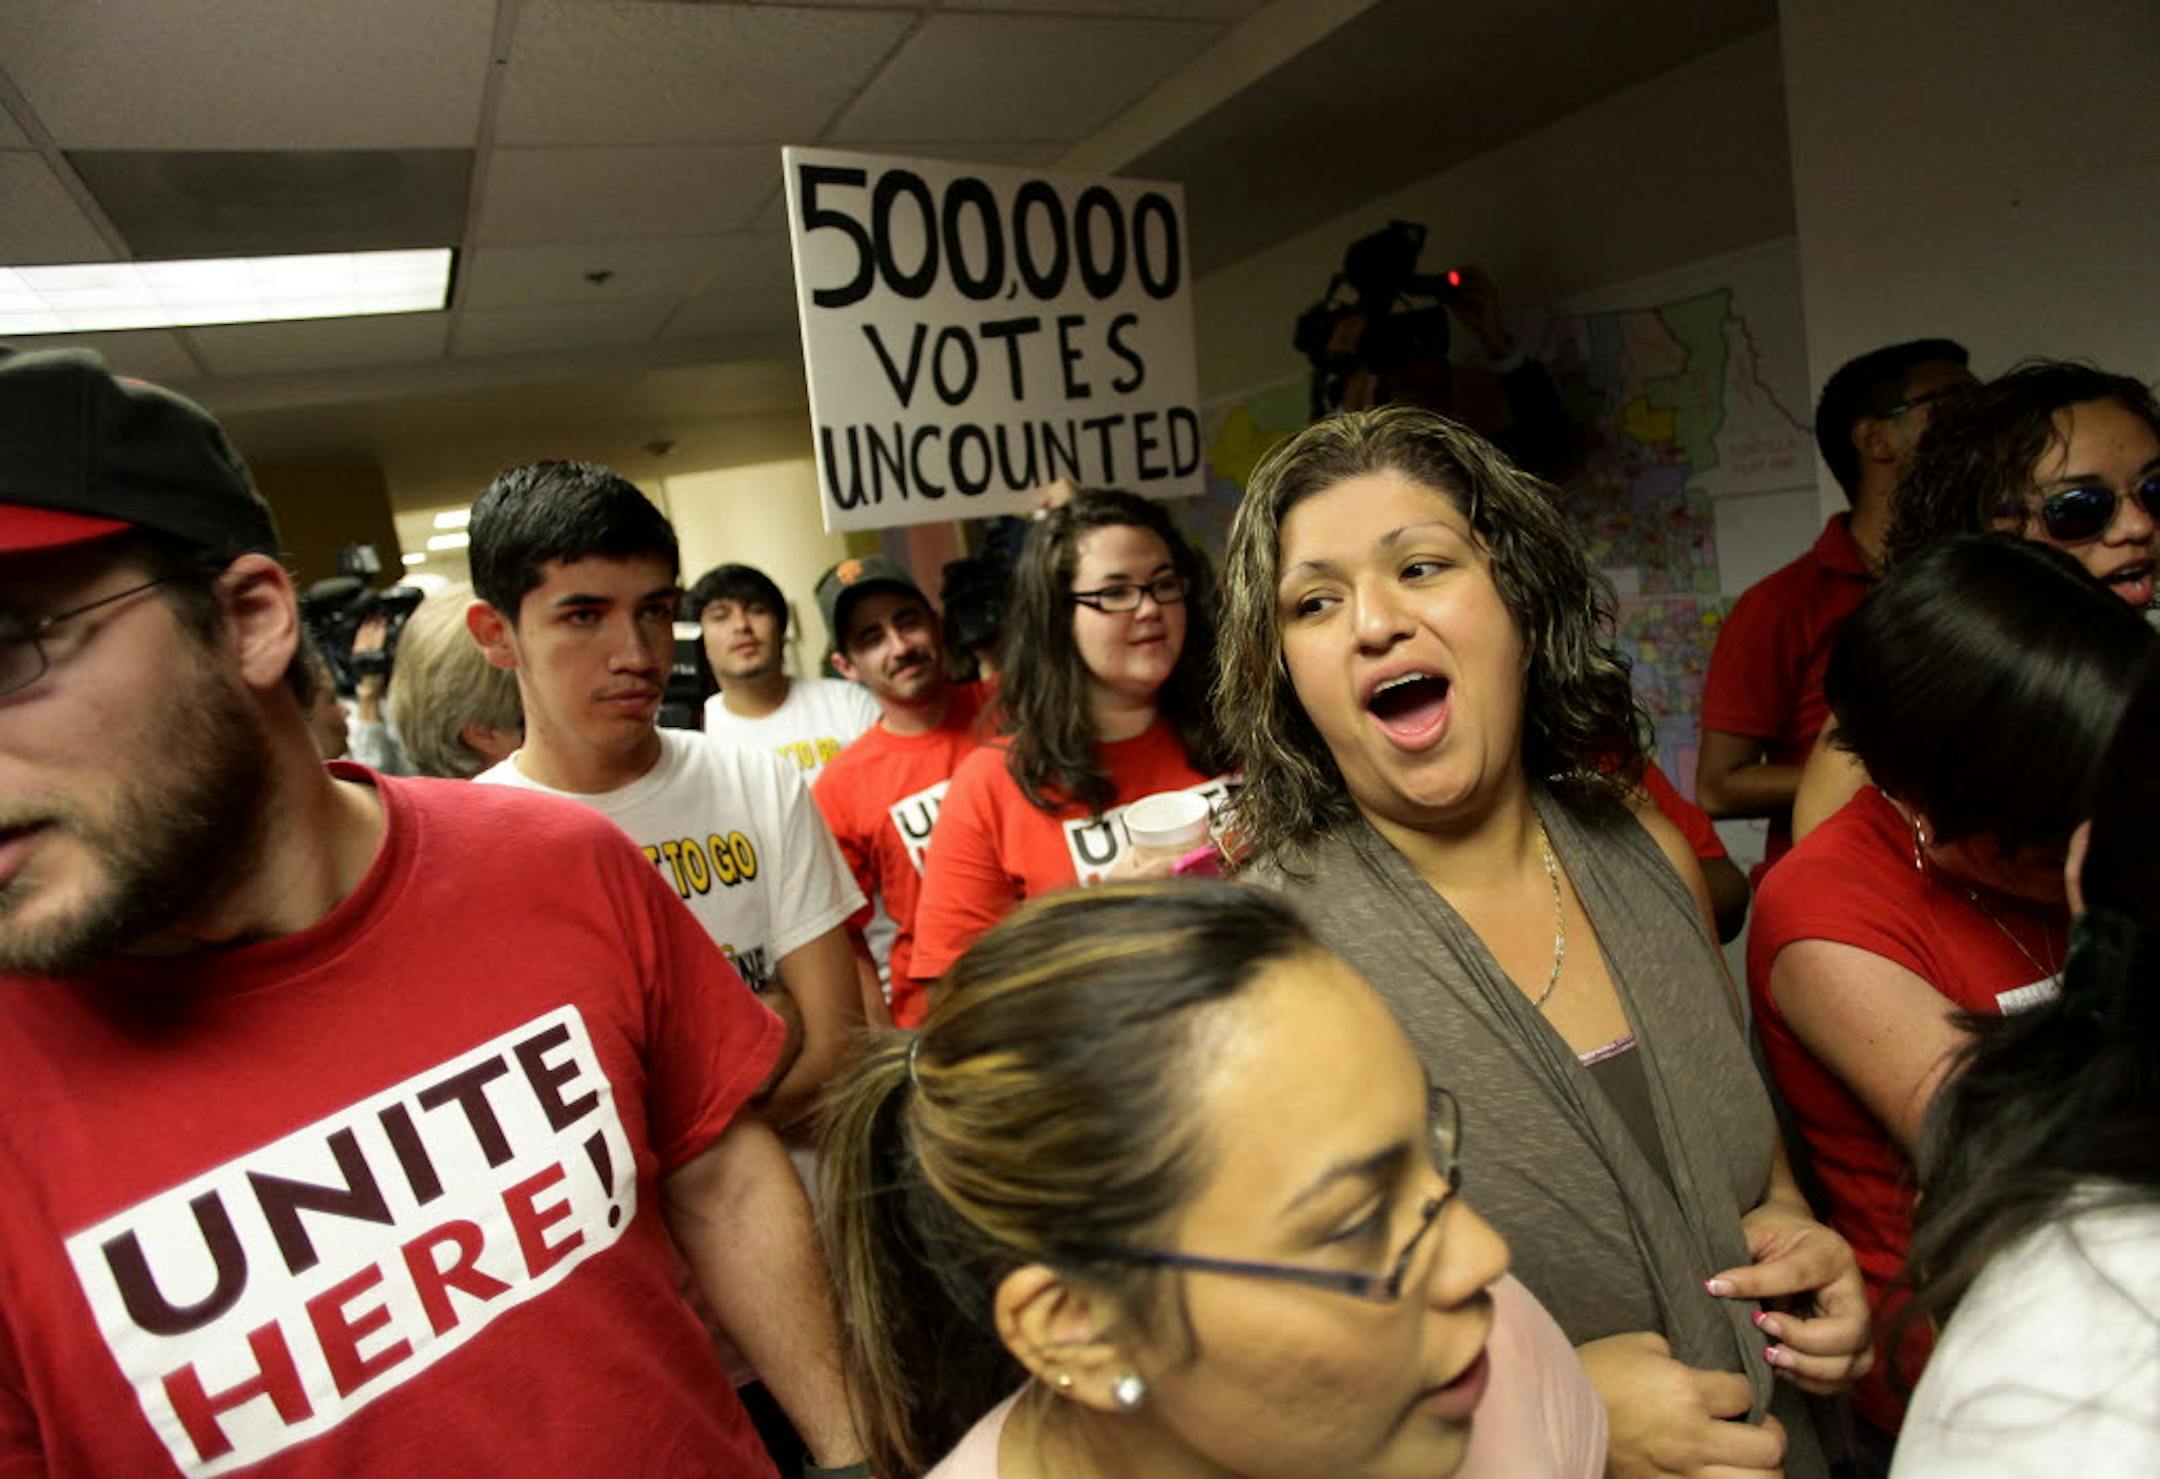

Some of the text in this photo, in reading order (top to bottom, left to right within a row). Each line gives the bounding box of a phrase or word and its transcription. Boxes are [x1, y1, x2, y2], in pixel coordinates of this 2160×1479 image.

[798, 163, 1180, 309] 500,000
[862, 312, 1146, 409] VOTES
[821, 406, 1200, 511] UNCOUNTED
[661, 830, 758, 900] TO GO
[100, 1021, 600, 1337] UNITE
[160, 1128, 621, 1464] HERE!
